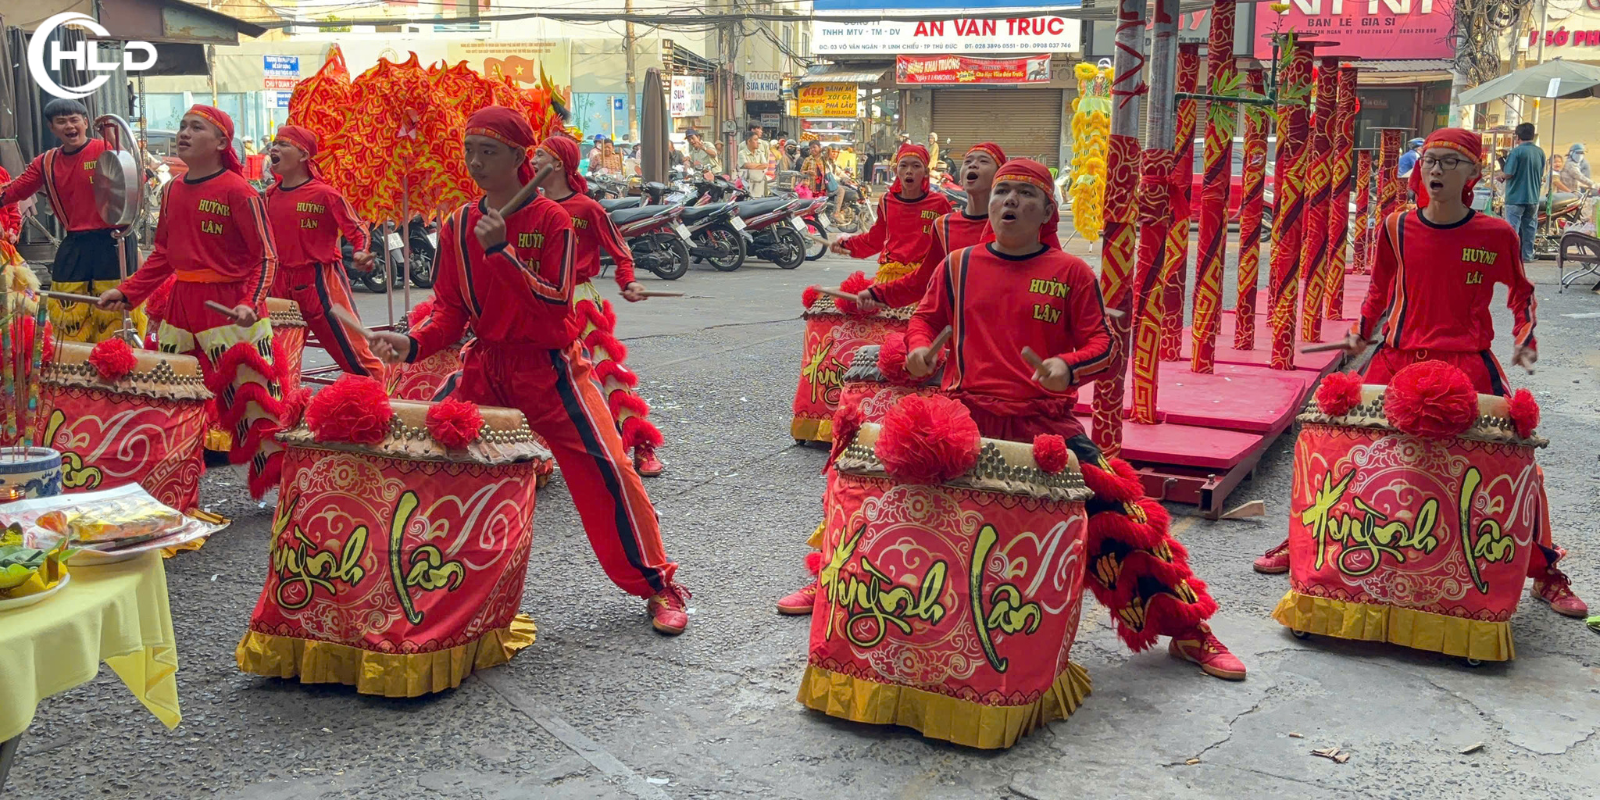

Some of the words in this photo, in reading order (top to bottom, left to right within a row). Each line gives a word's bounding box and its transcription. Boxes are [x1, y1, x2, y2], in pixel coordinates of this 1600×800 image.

[822, 28, 844, 36] TNHH
[847, 28, 864, 36] MTV
[871, 28, 882, 36] TM
[889, 28, 901, 36] DV
[925, 60, 938, 73] KHAI
[1029, 278, 1070, 298] HUỲN
[1033, 304, 1061, 324] LÂN
